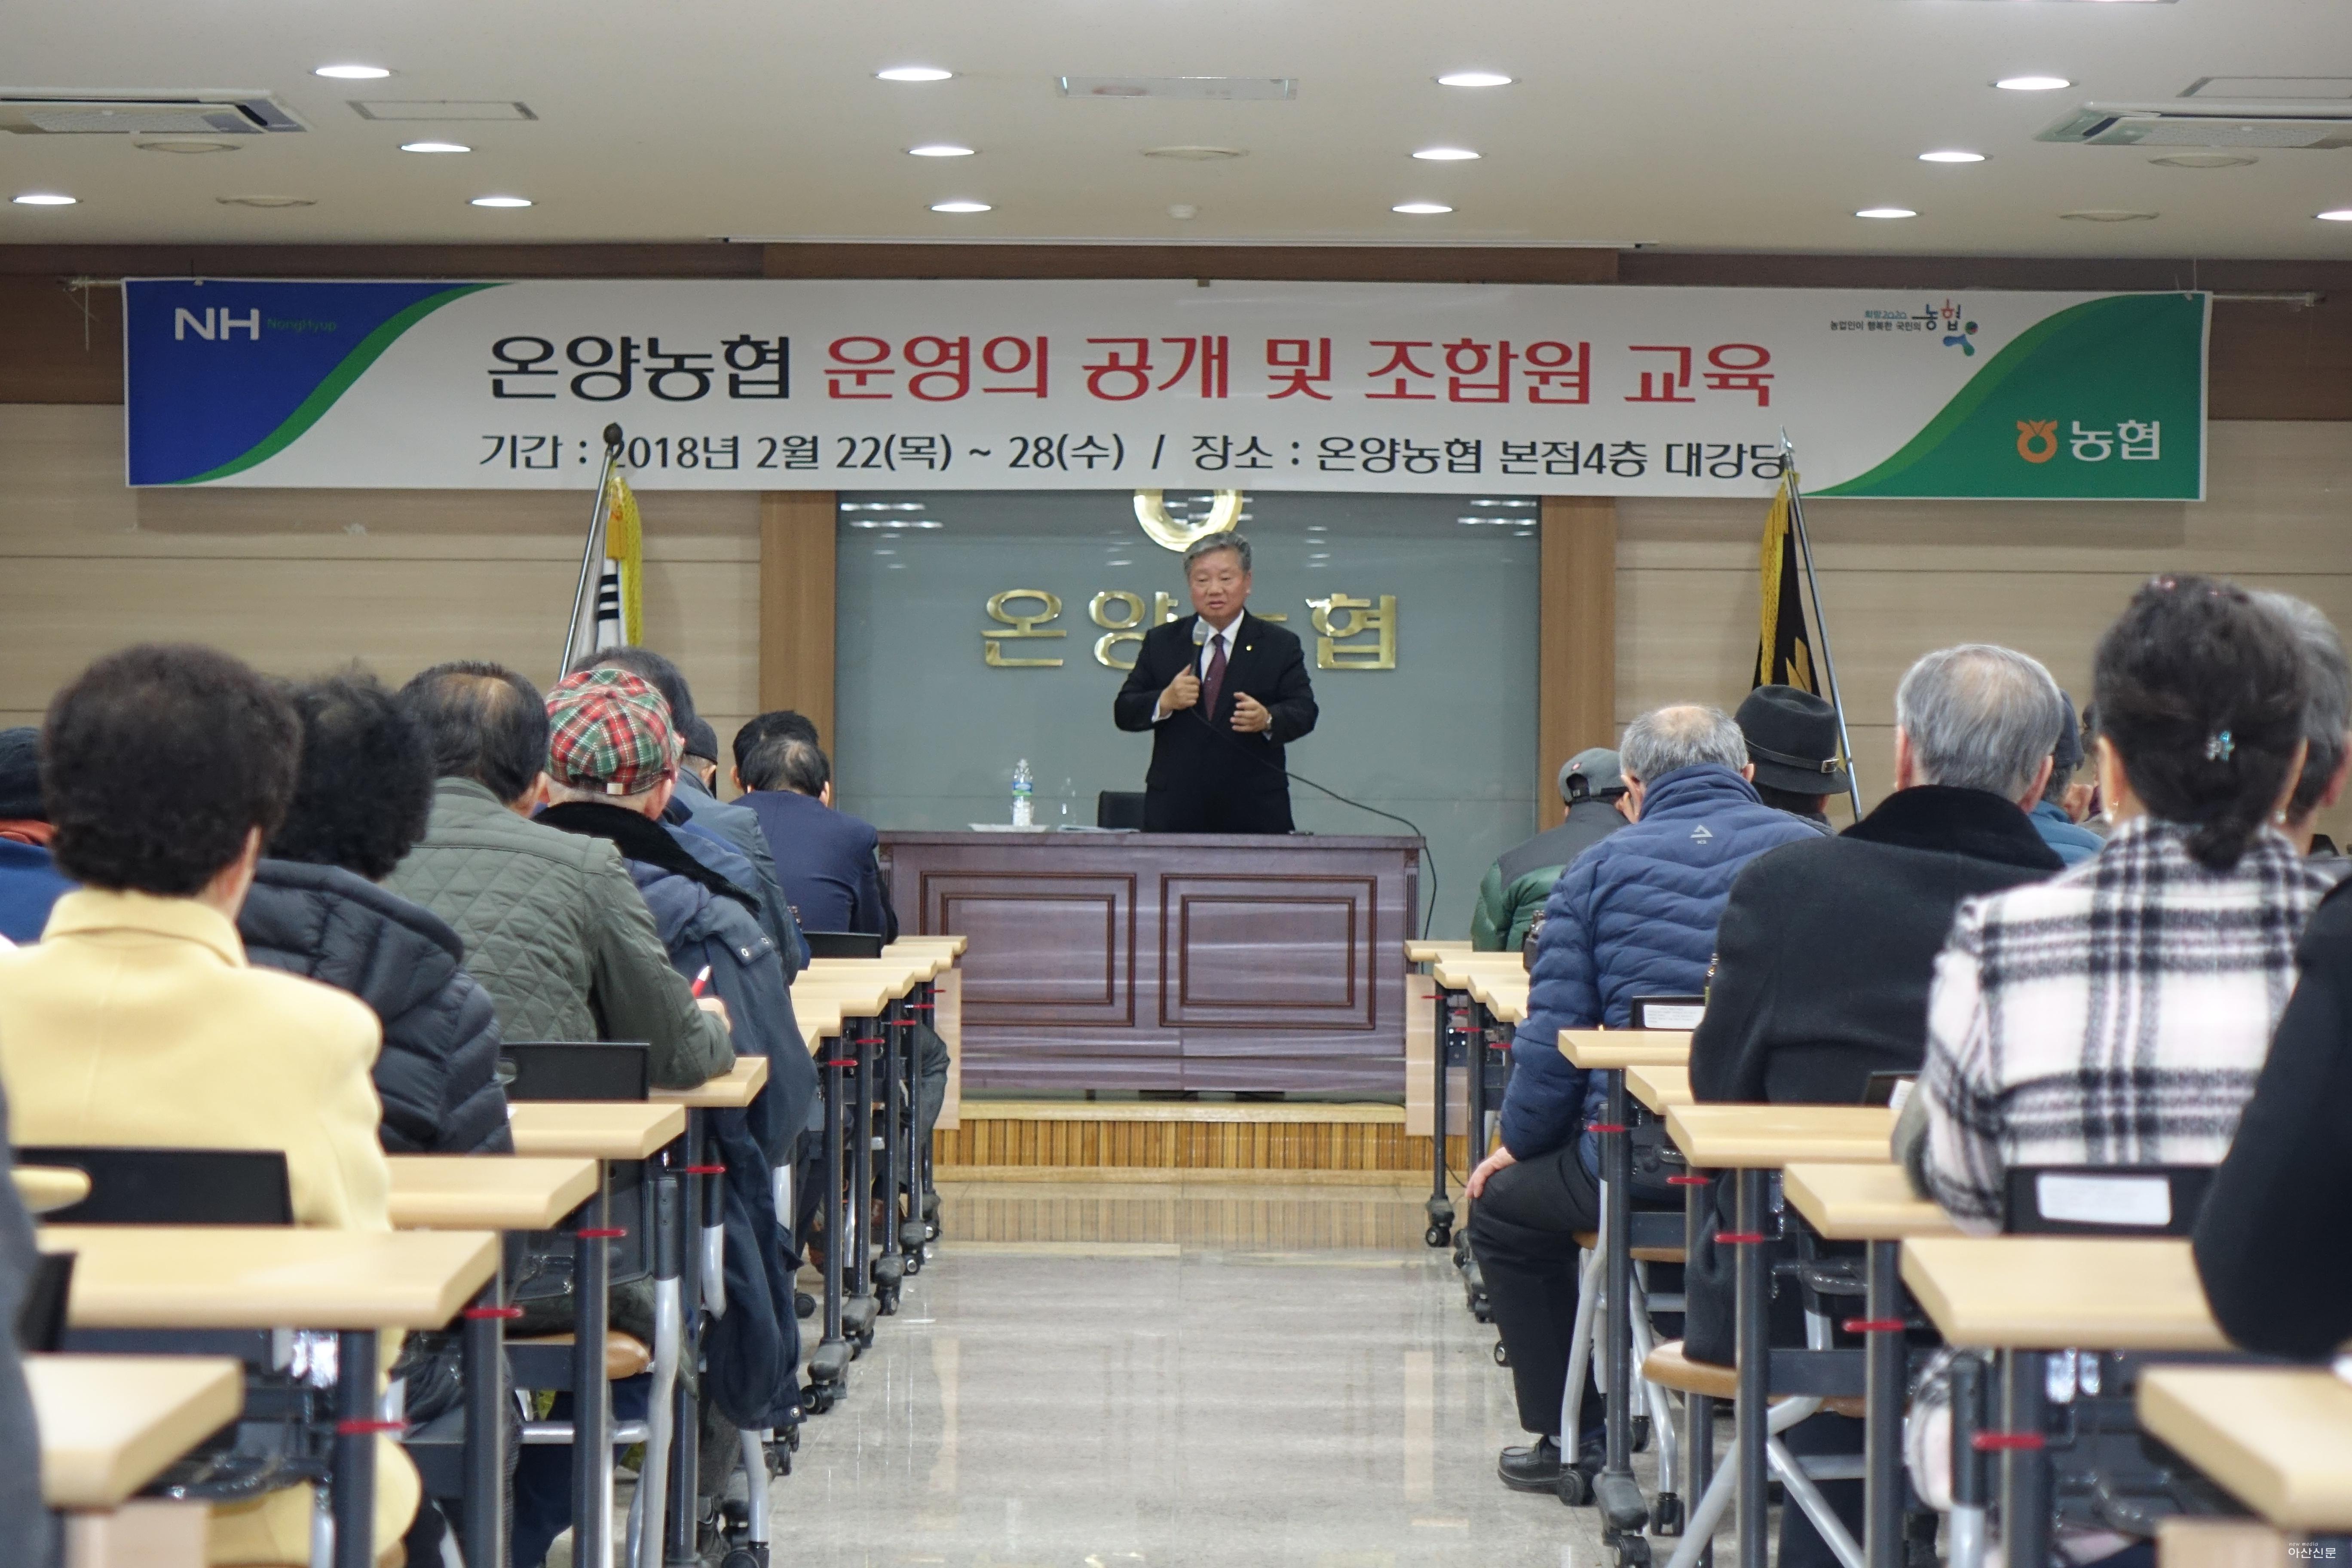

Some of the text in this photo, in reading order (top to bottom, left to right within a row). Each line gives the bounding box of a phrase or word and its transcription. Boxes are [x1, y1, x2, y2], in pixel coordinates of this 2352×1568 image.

[175, 307, 260, 340] NH
[1830, 299, 1961, 331] 농업인이 행복한 국민의 농협
[487, 334, 1774, 407] 온양농협 운영의 공개 및 조합원 교육
[479, 435, 563, 469] 기간
[756, 435, 819, 470] 2월
[836, 434, 952, 472] 22(목)
[1008, 433, 1124, 471] 28(수)
[1191, 435, 1274, 471] 장소
[1317, 436, 1482, 475] 온양농협
[1499, 440, 1648, 478] 본점4층
[2069, 420, 2160, 461] 농협
[980, 588, 1397, 670] 온양협
